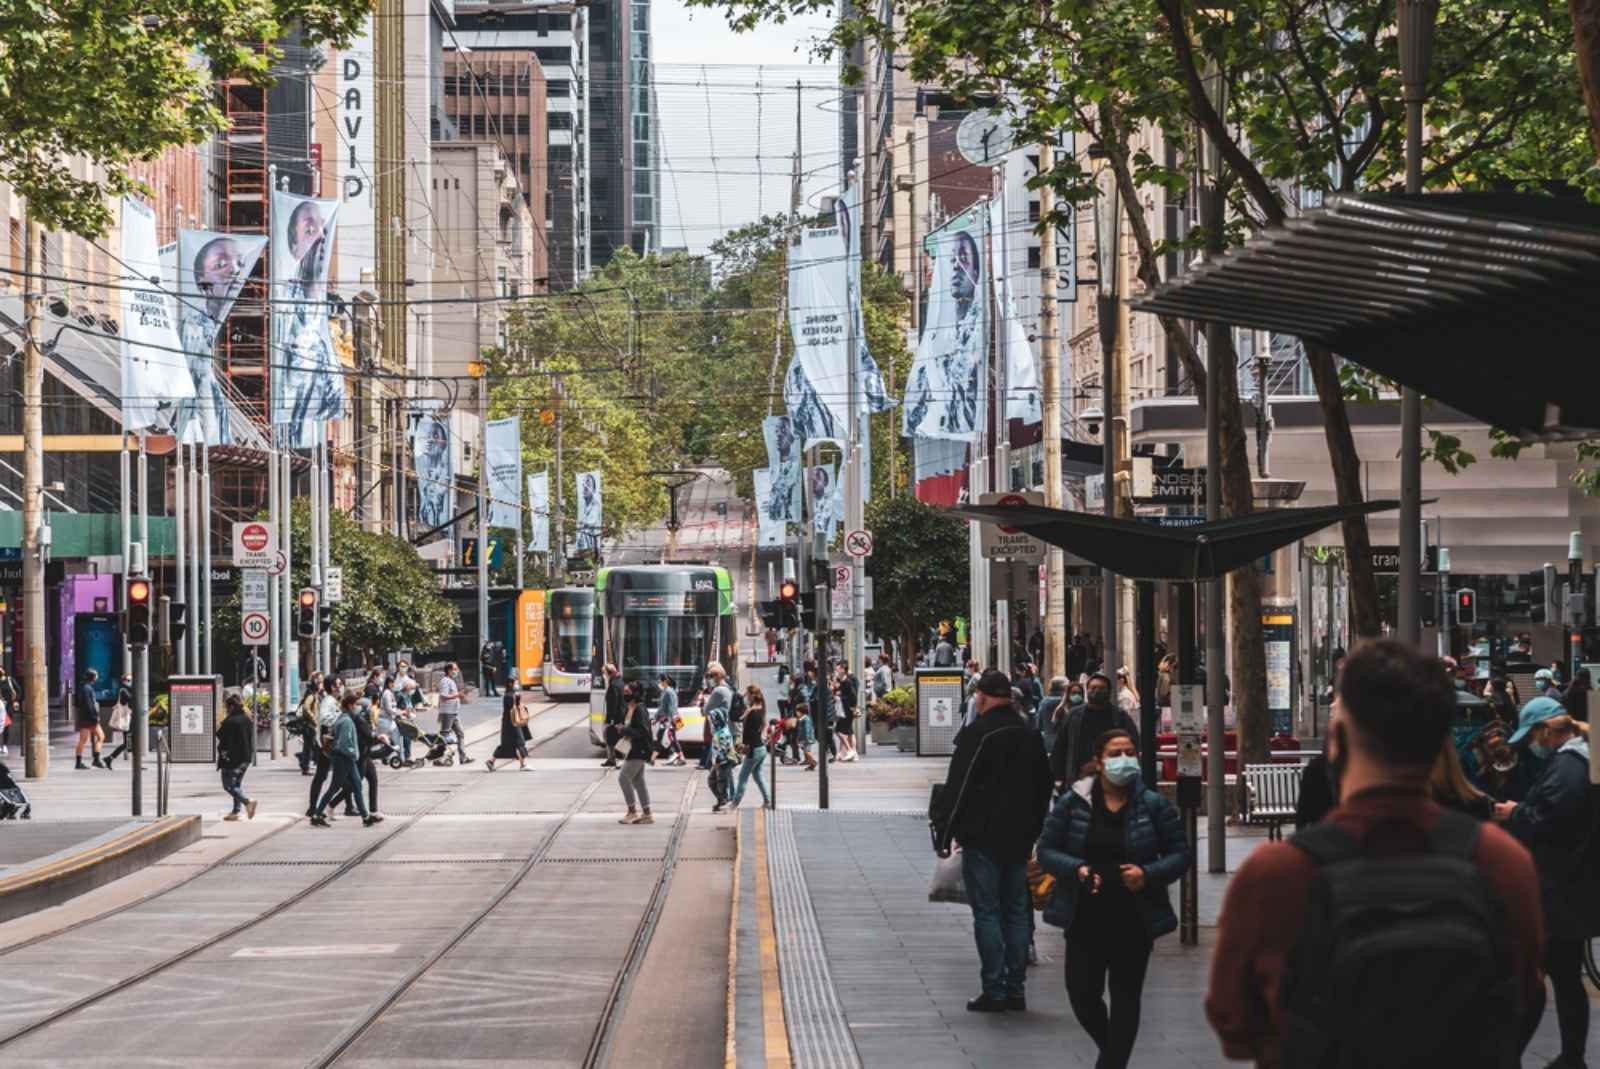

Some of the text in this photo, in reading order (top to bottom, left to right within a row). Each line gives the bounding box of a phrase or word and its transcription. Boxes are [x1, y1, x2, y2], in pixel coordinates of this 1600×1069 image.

[343, 59, 363, 199] DAVID
[1151, 486, 1203, 496] SMITH
[998, 535, 1029, 545] TRAMS
[990, 545, 1037, 555] EXCEPTED
[249, 621, 263, 633] 10
